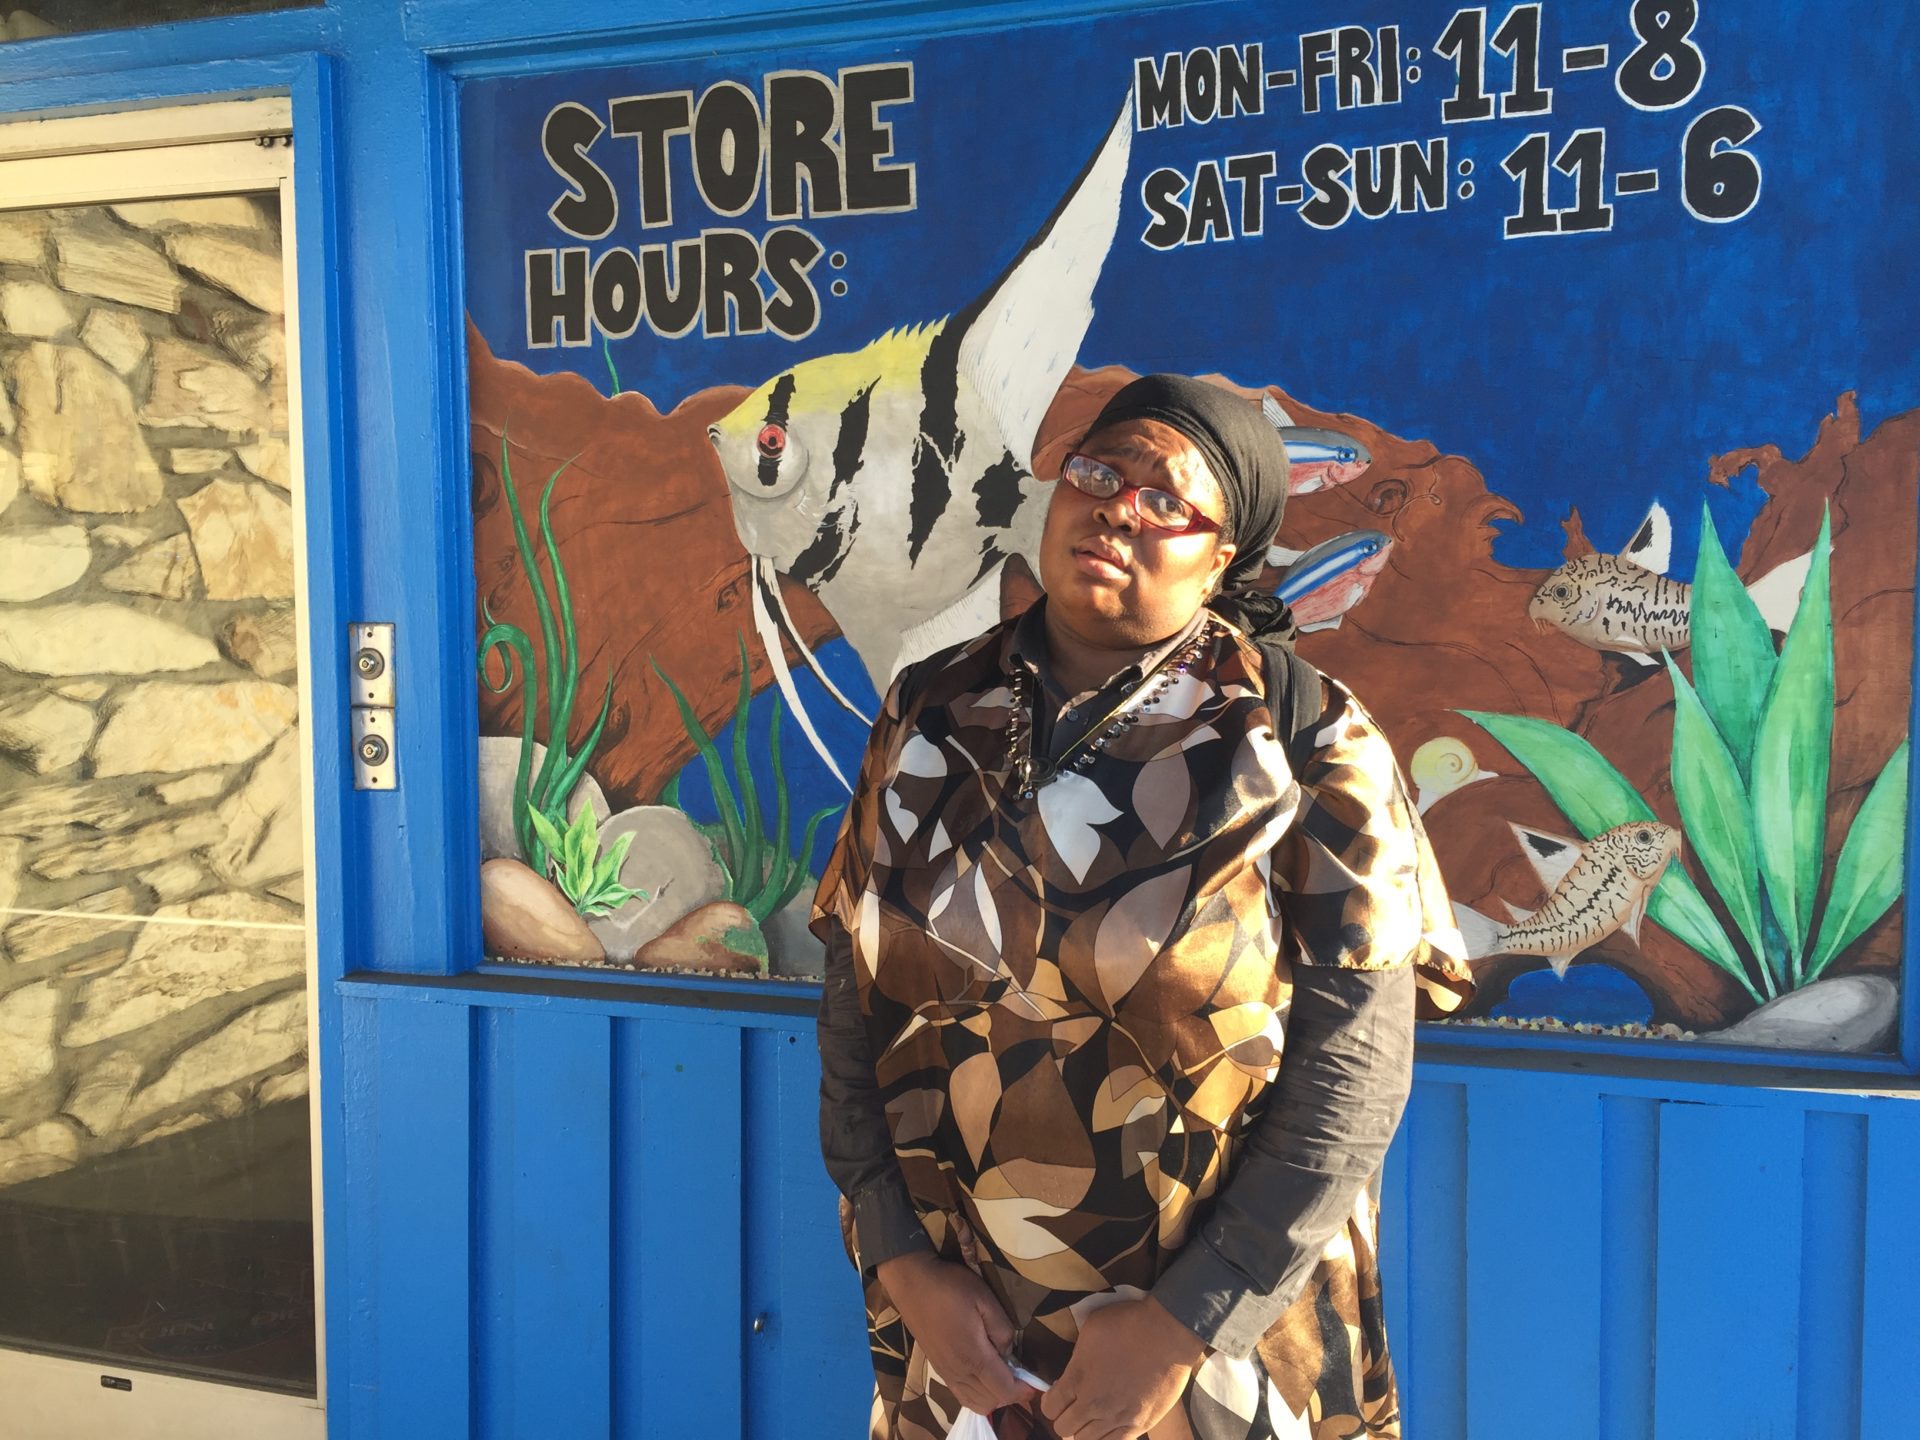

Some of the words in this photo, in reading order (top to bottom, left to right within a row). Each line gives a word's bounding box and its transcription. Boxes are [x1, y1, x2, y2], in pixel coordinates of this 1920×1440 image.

[1134, 25, 1421, 131] MON-FRI:
[542, 62, 917, 240] STORE
[1141, 138, 1475, 251] SAT-SUN:
[525, 225, 848, 349] HOURS:
